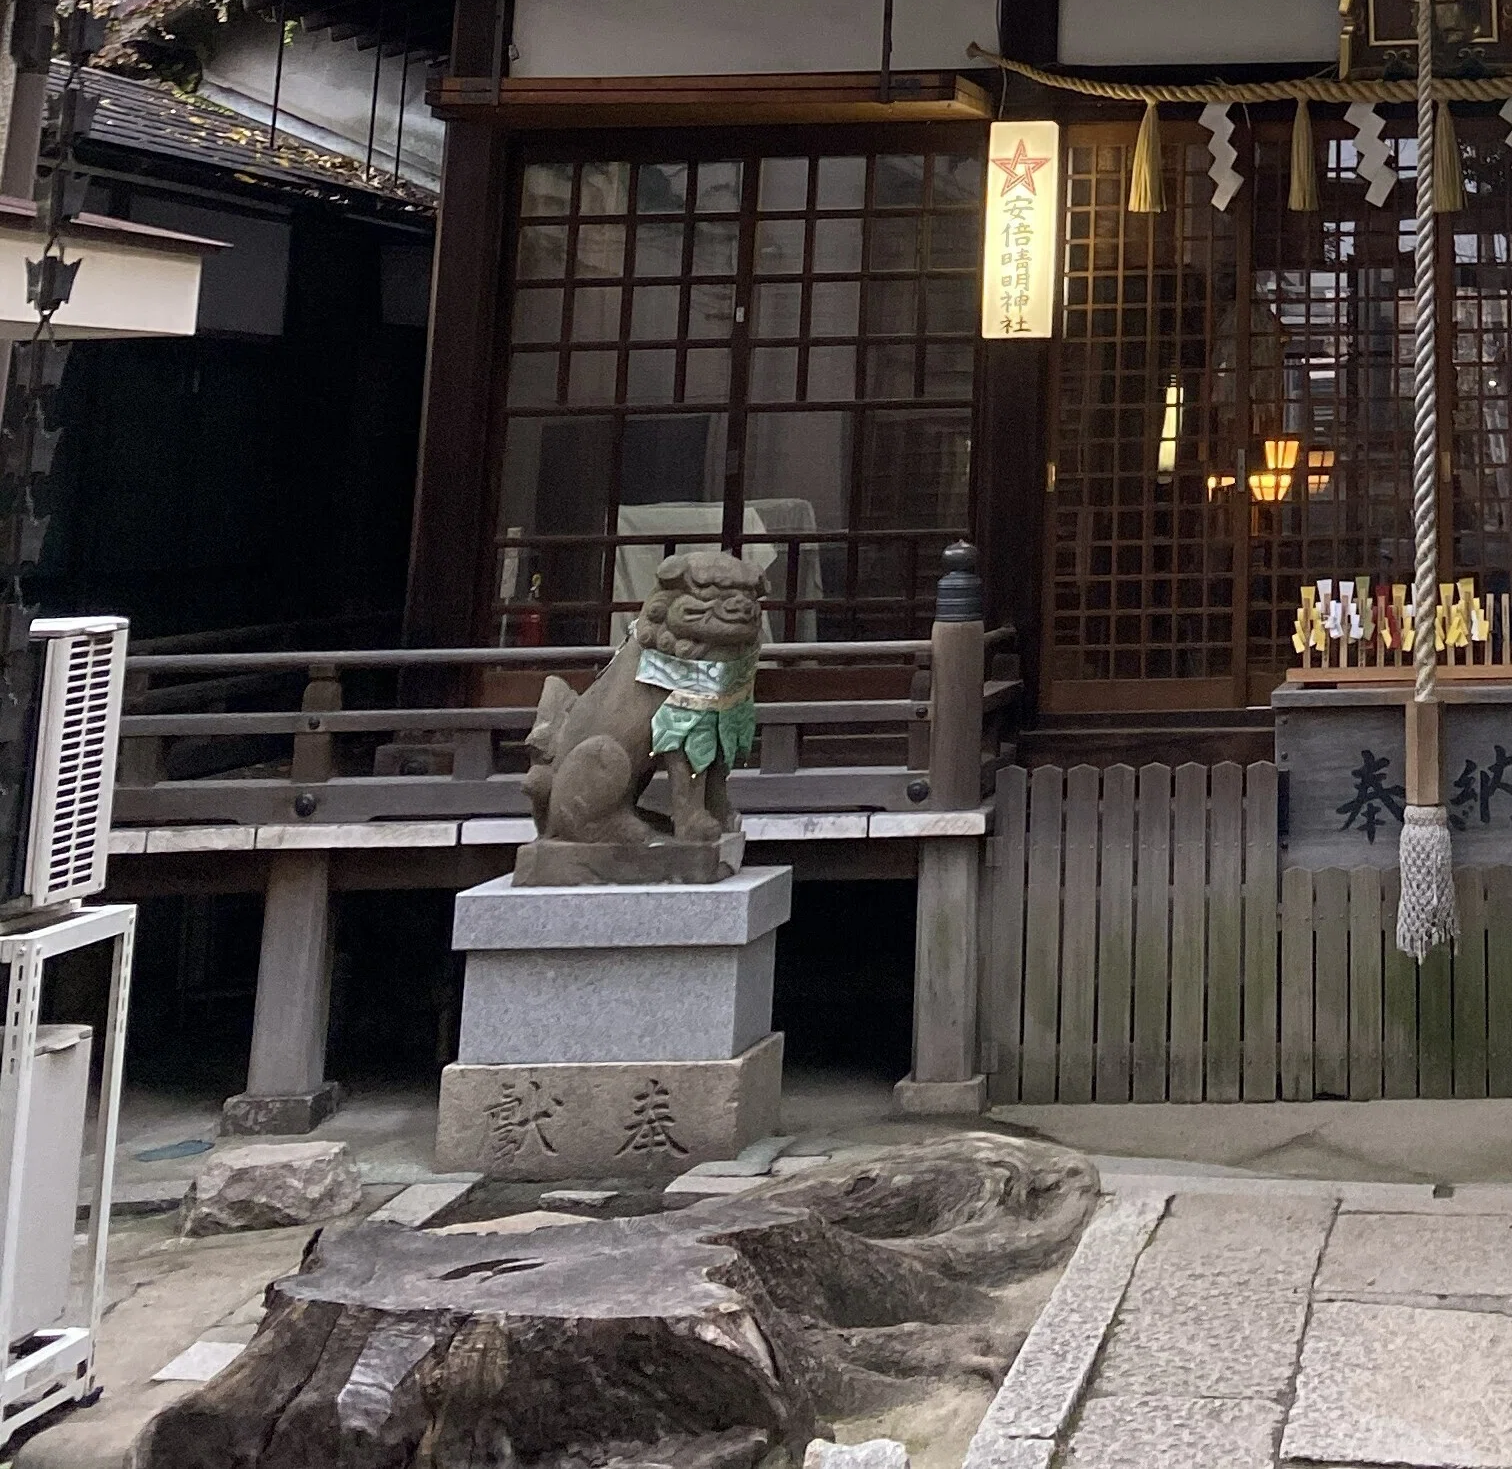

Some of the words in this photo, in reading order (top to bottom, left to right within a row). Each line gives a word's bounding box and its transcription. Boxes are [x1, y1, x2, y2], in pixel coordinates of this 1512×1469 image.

[1000, 195, 1035, 334] 安倍晴明神社
